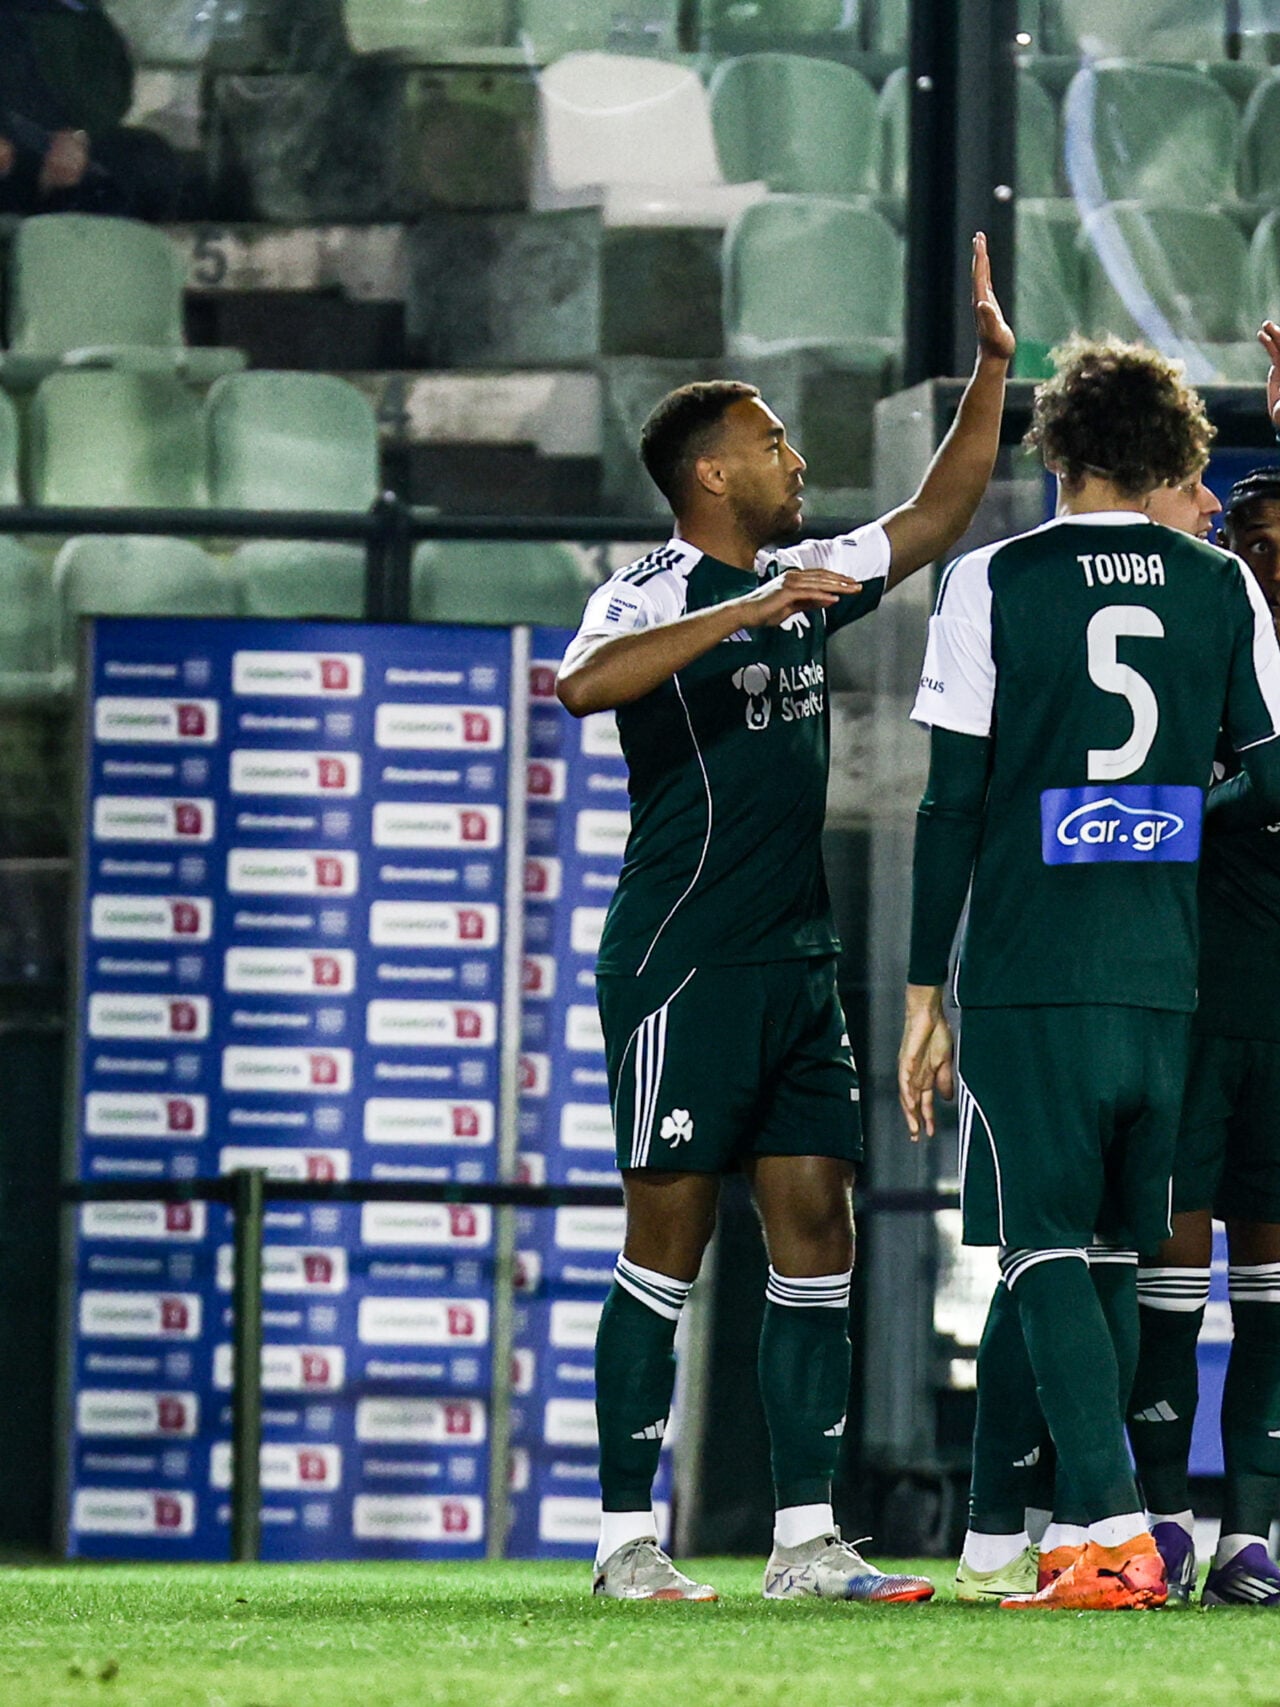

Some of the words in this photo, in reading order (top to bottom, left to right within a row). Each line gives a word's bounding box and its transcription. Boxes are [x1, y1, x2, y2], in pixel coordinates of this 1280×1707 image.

[1077, 553, 1165, 587] TOUBA
[920, 675, 945, 694] eus
[1087, 605, 1165, 782] 5
